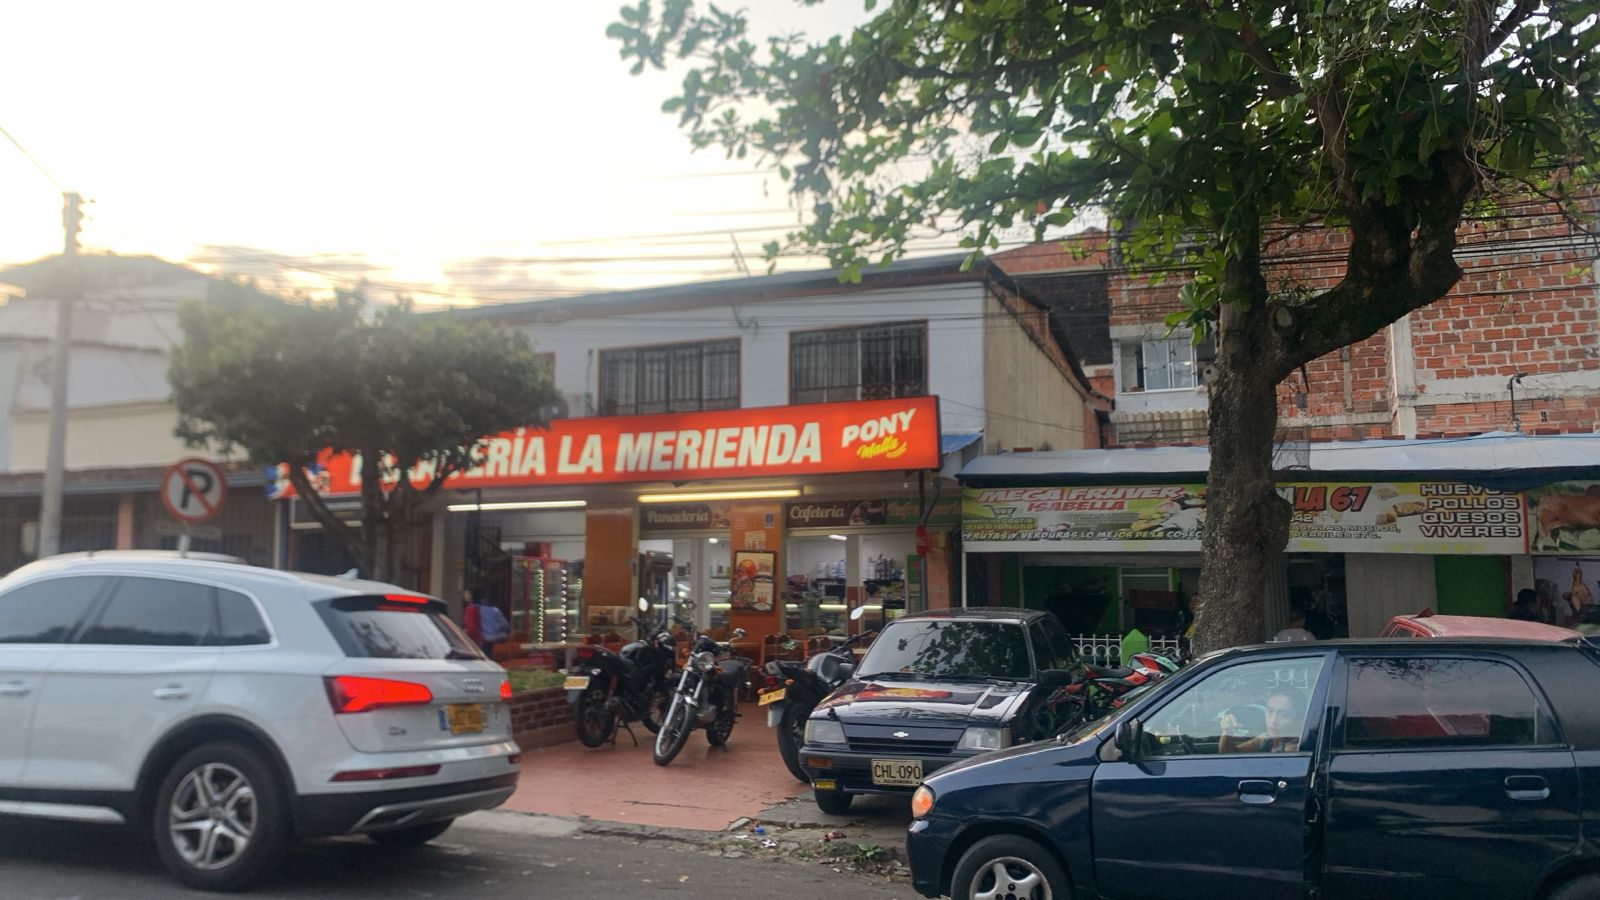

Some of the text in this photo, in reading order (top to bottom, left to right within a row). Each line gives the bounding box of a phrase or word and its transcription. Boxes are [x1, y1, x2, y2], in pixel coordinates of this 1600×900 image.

[841, 407, 917, 448] PONY
[557, 433, 604, 474] LA
[613, 422, 822, 473] MERIENDA
[856, 435, 899, 459] Malta
[976, 486, 1186, 502] MEGA FRUVER
[1420, 484, 1519, 496] HUEV
[1330, 485, 1373, 512] 67
[1427, 497, 1520, 509] POLLOS
[1028, 501, 1124, 511] ISABELLA
[1421, 511, 1521, 524] QUESOS
[1020, 531, 1079, 540] VERDURAS
[1080, 531, 1095, 539] LO
[1096, 530, 1133, 539] MEJOR
[1166, 529, 1203, 538] COSEC
[1419, 525, 1522, 538] VIVERES
